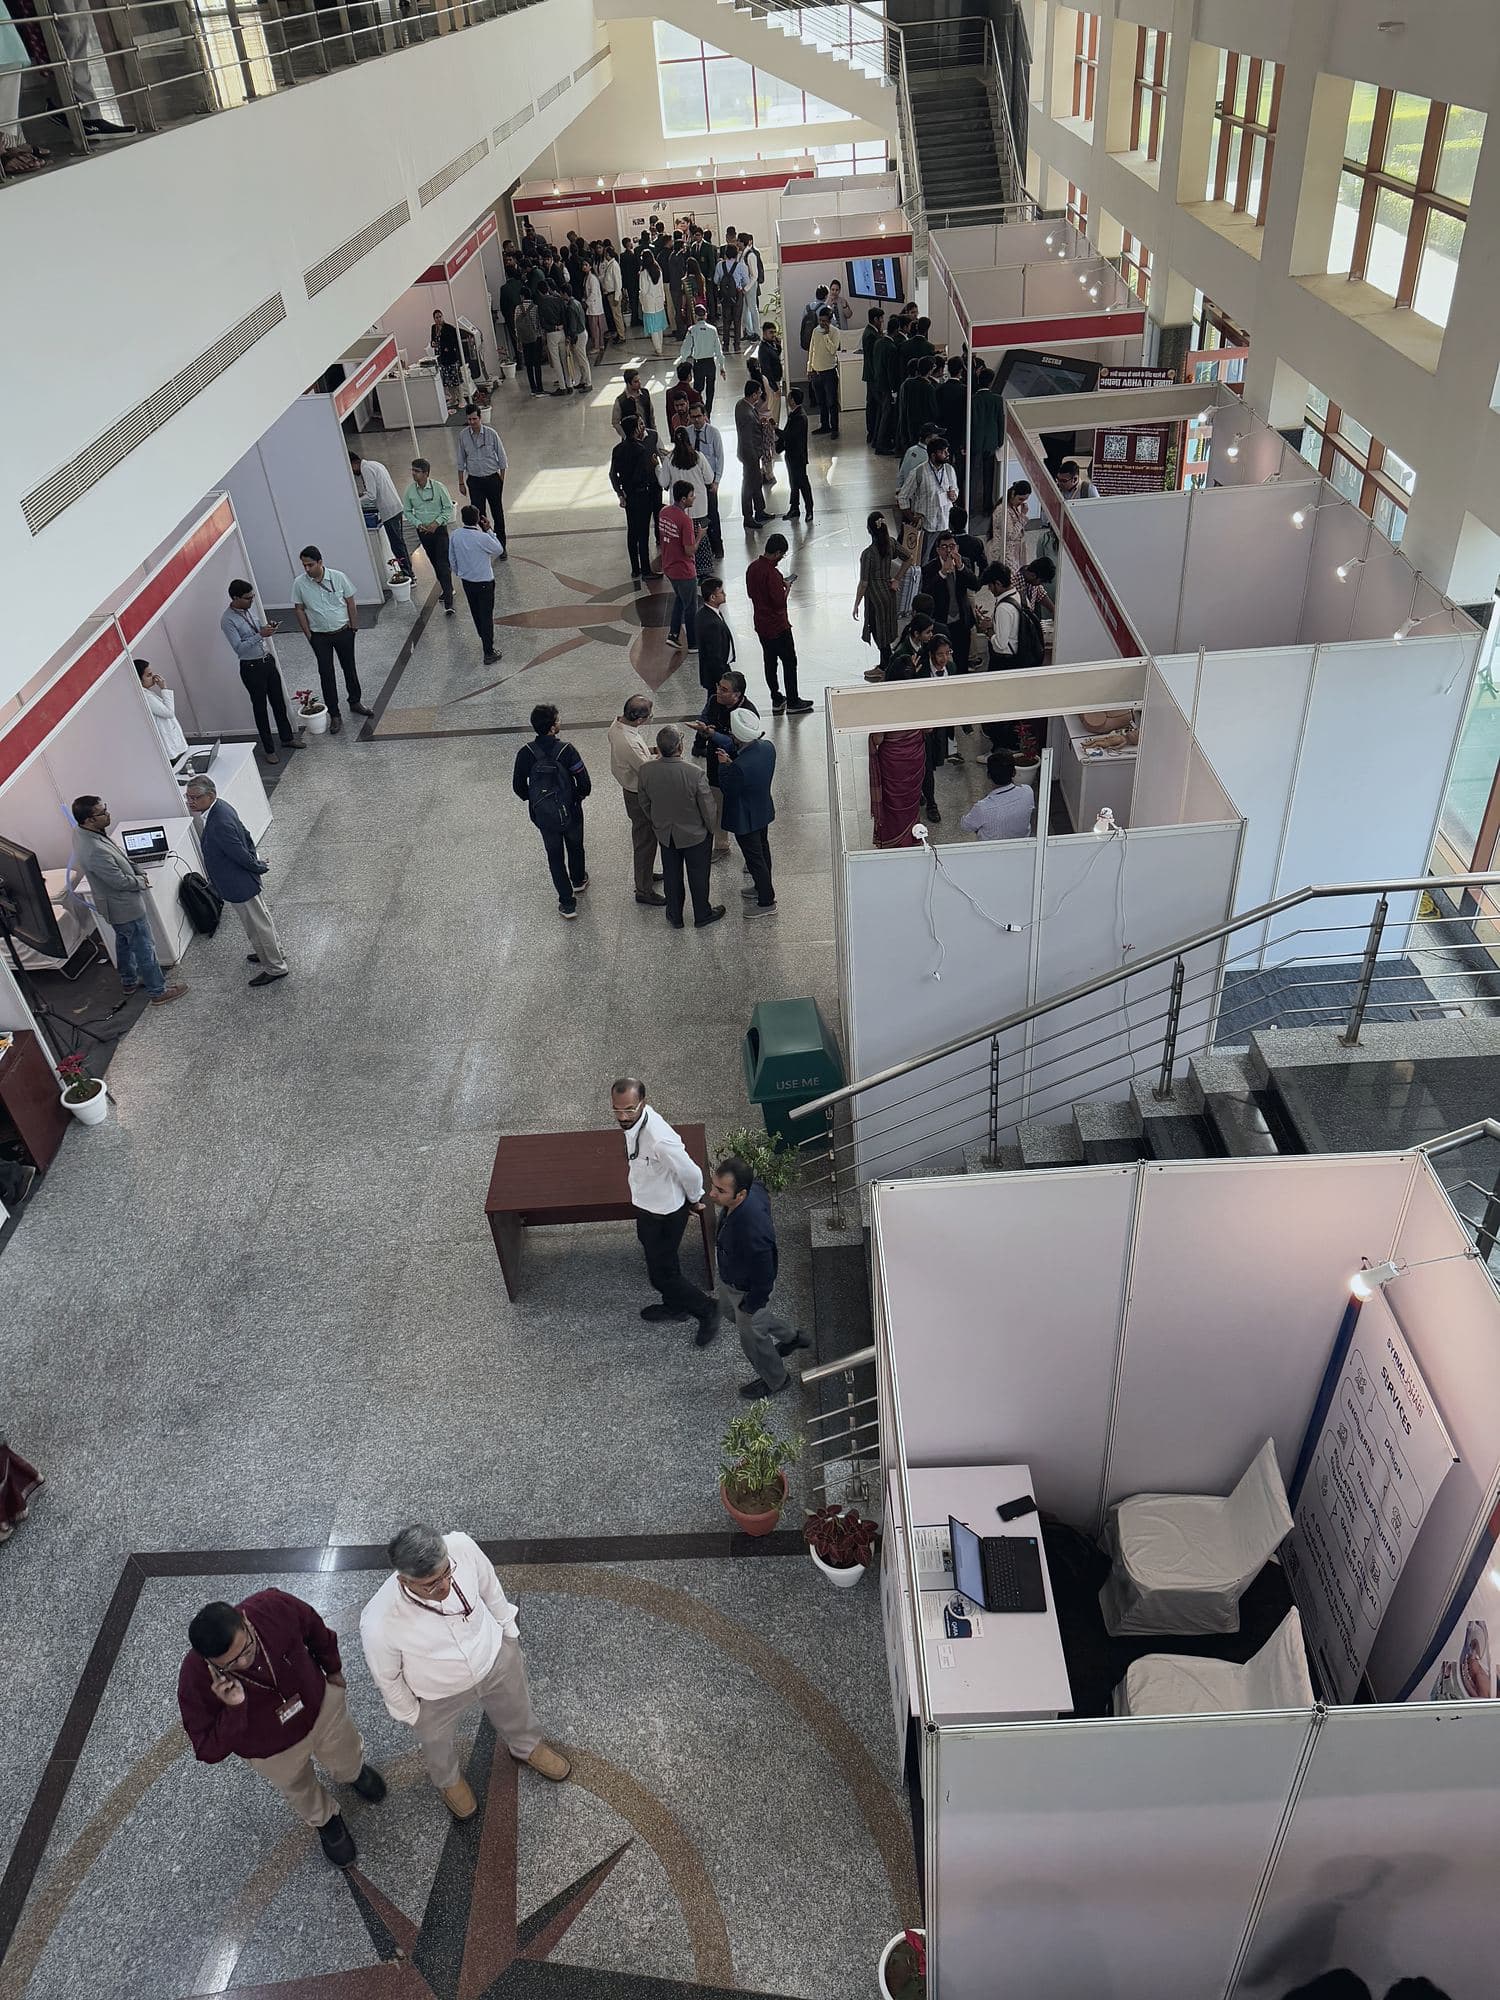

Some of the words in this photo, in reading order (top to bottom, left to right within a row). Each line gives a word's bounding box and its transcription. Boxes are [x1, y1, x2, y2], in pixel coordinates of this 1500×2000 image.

[776, 1079, 798, 1090] USE
[802, 1077, 820, 1088] ME
[1380, 1366, 1412, 1436] SERVICES
[1347, 1398, 1376, 1467] ENGINEERING
[1384, 1438, 1403, 1480] DESIGN
[1356, 1470, 1396, 1565] MANUFACTURING
[1357, 1560, 1377, 1610] CLINICAL
